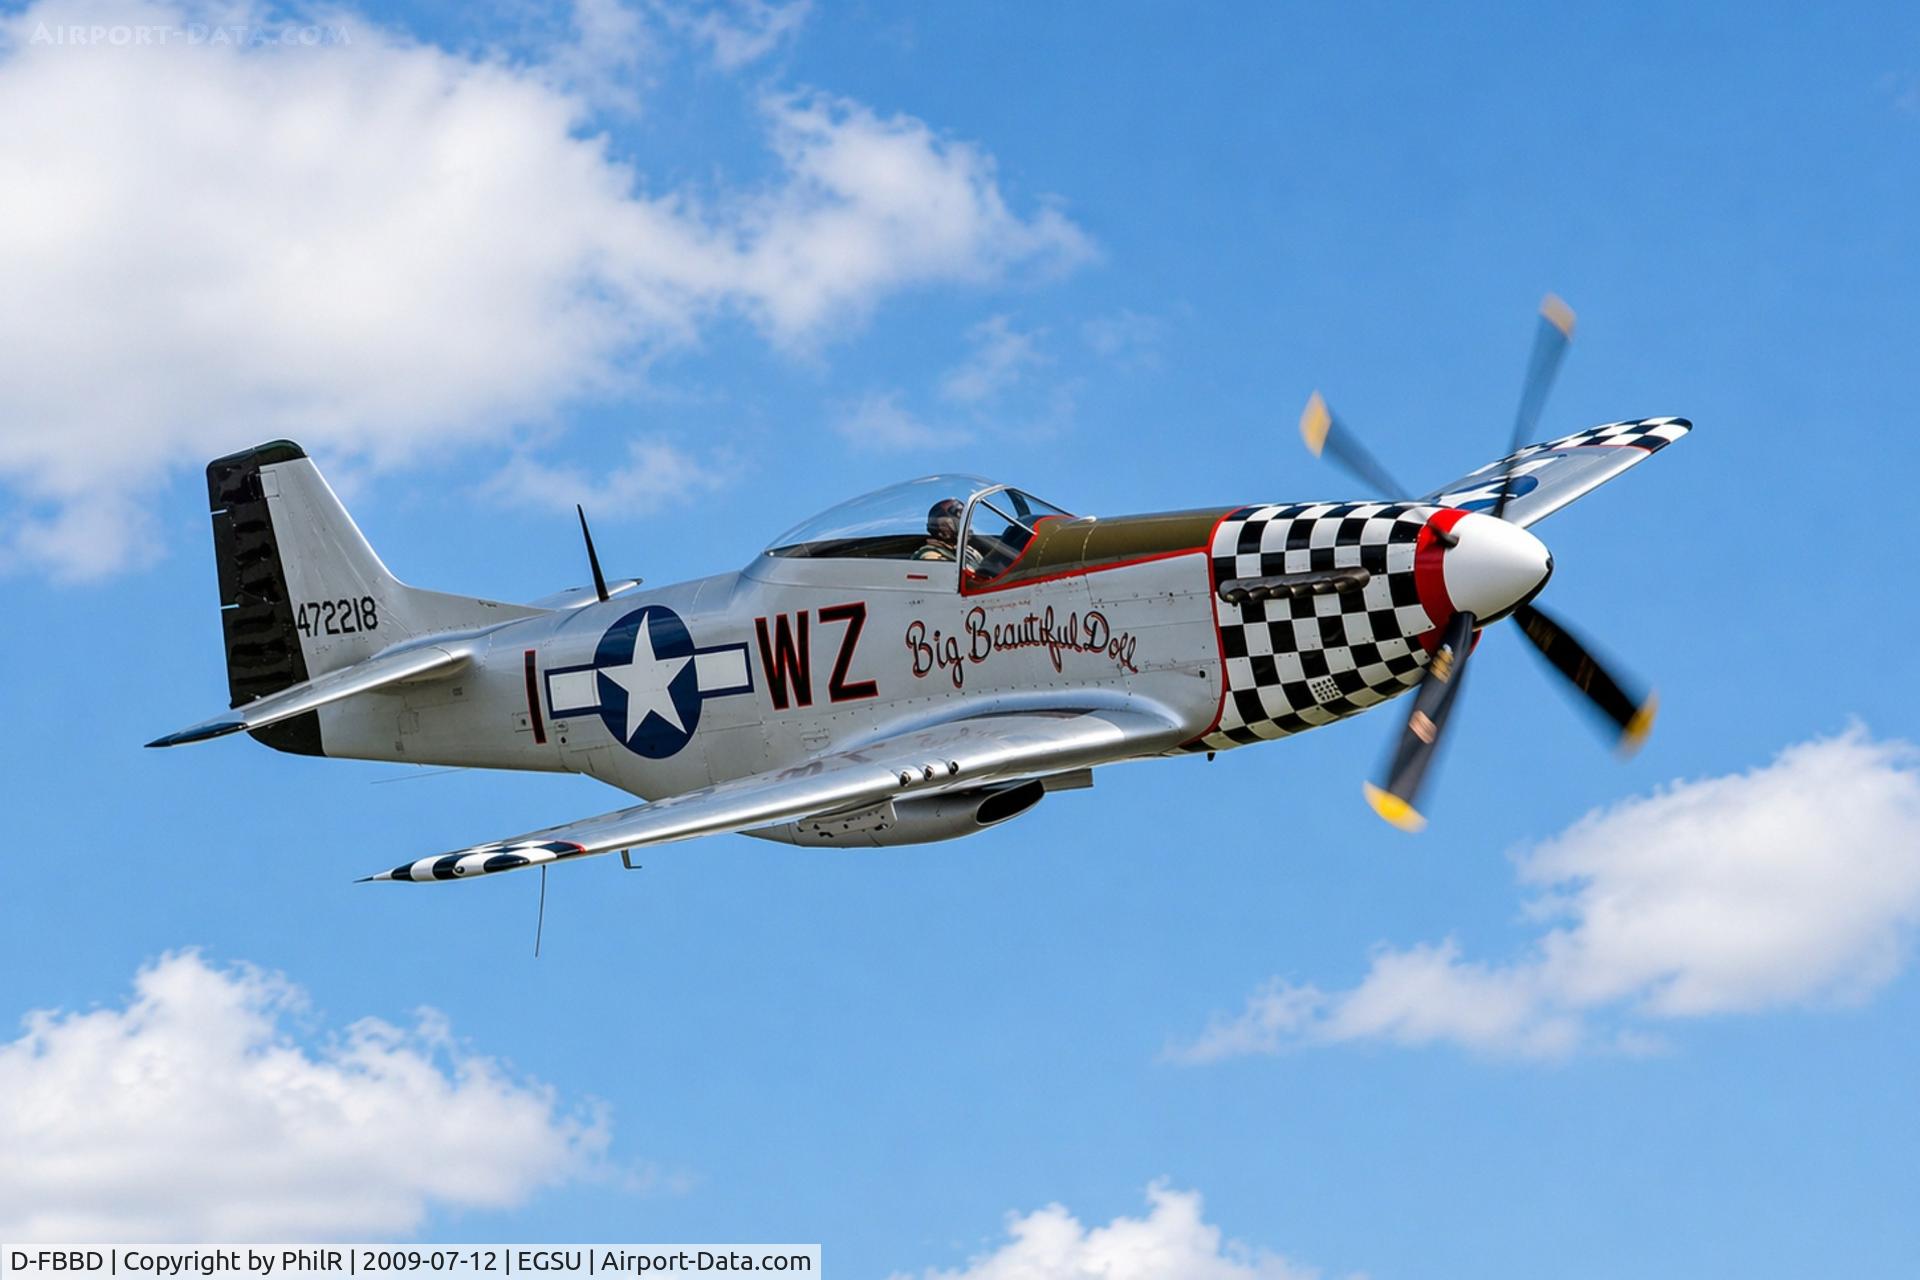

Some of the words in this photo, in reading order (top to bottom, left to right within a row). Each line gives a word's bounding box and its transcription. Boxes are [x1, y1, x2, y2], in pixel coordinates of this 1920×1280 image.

[297, 596, 379, 638] 472218
[754, 601, 879, 711] WZ
[905, 620, 964, 688] Big
[965, 605, 1083, 674] Beautiful
[1083, 611, 1138, 674] Doll
